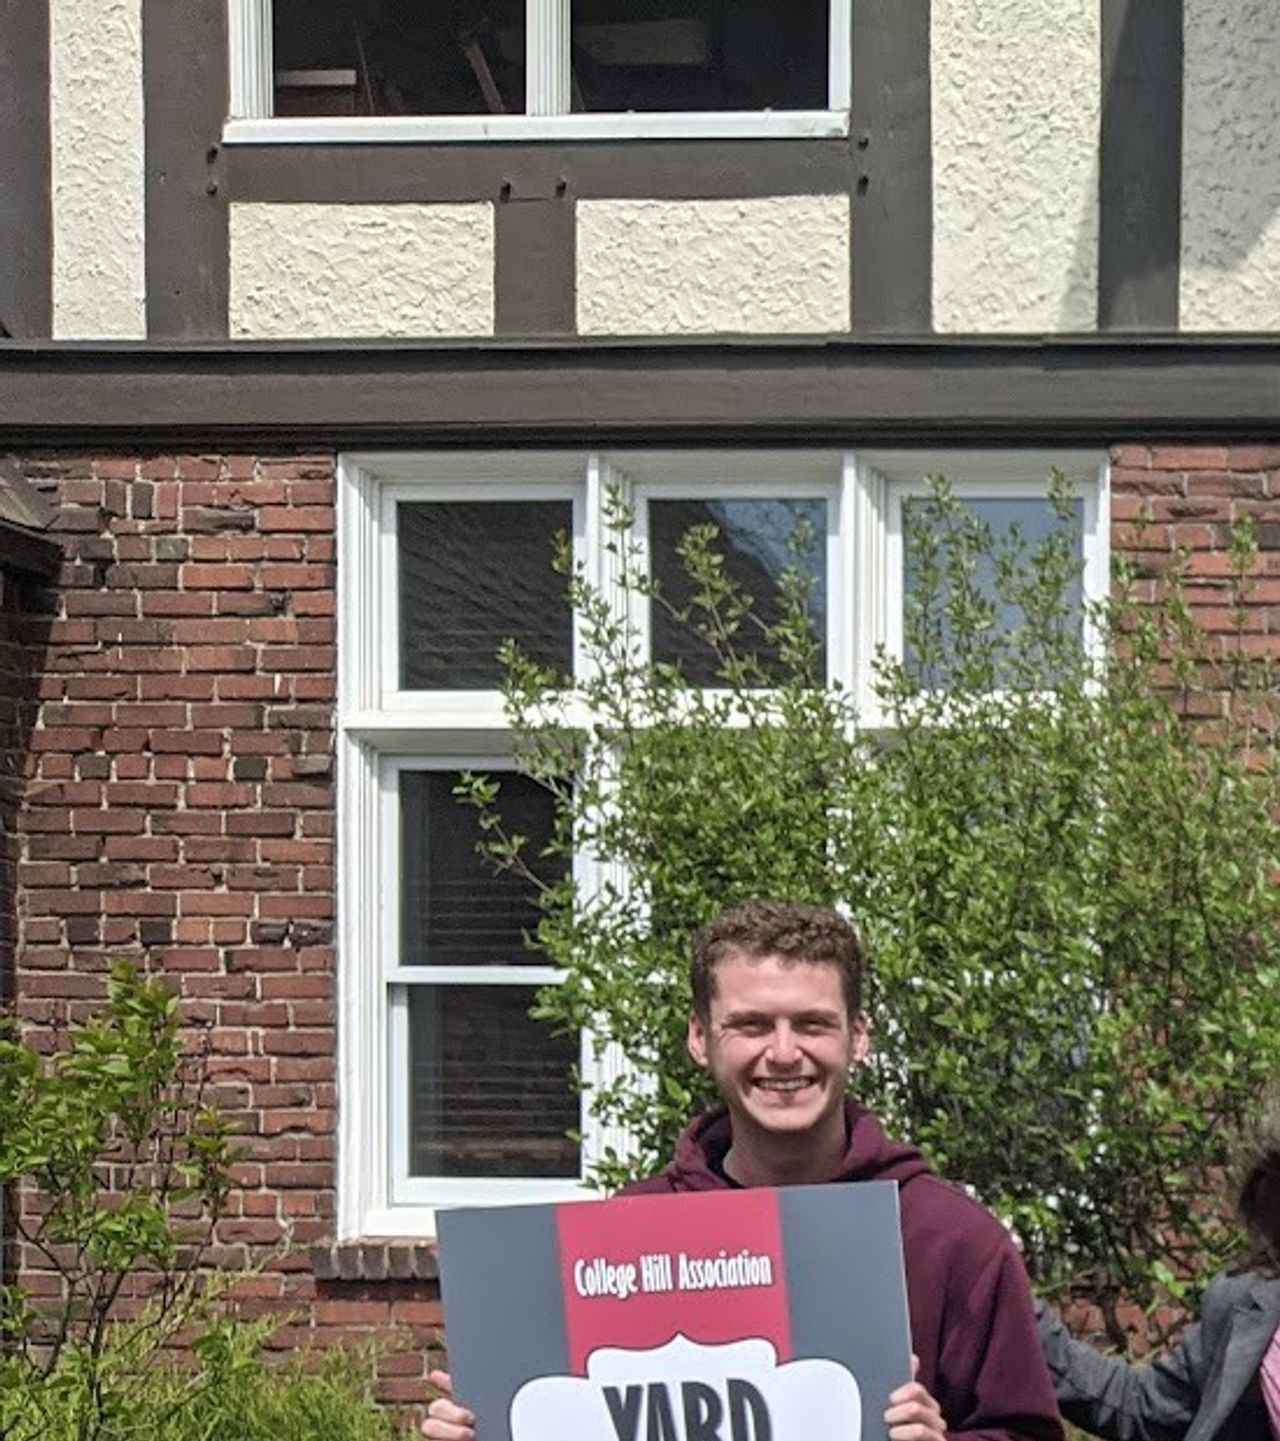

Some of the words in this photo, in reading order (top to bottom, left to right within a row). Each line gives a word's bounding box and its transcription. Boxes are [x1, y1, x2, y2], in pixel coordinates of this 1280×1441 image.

[575, 1257, 638, 1299] College
[640, 1253, 673, 1292] Hill
[678, 1248, 773, 1291] Association
